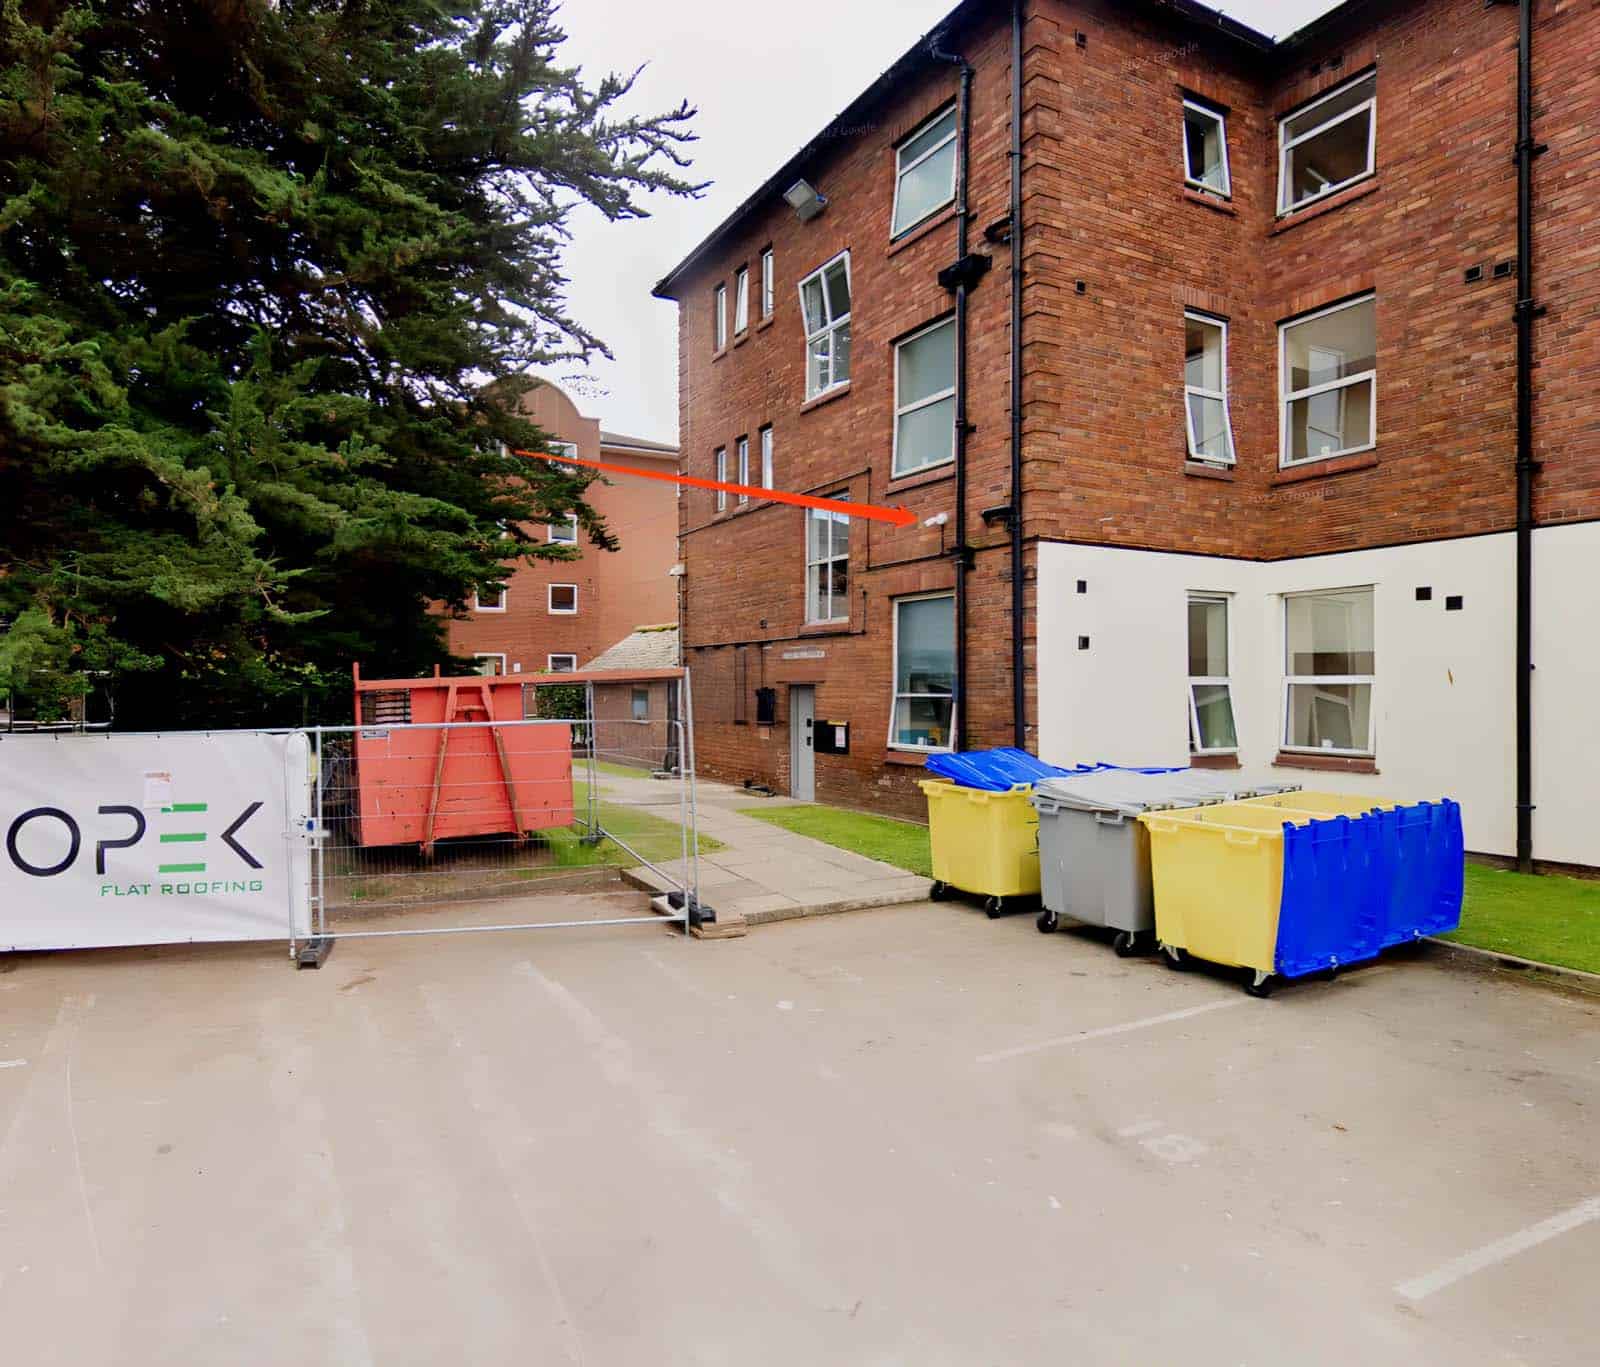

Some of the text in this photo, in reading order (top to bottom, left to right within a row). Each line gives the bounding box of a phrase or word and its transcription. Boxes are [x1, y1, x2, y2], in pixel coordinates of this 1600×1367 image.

[6, 802, 264, 877] OPEK
[101, 880, 264, 897] FLAT ROOFING
